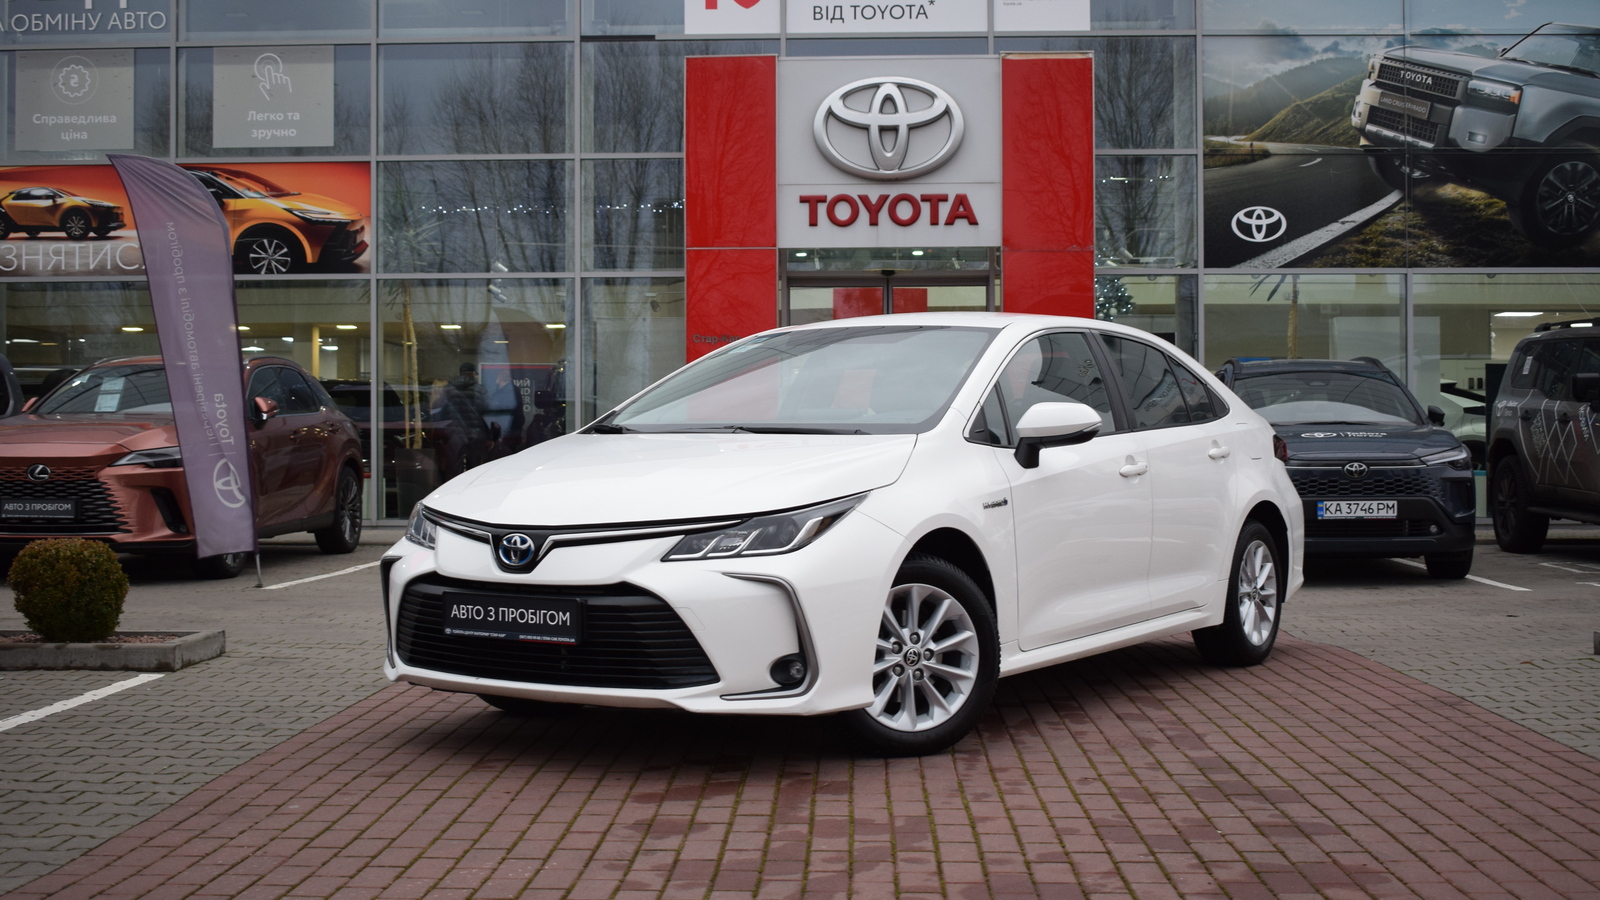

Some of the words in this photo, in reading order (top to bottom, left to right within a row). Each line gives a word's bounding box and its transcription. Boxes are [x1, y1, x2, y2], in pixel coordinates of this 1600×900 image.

[813, 5, 845, 24] ВІД
[11, 12, 102, 32] ОБМІНУ
[107, 11, 167, 30] АВТО
[1401, 71, 1432, 84] TOYOTA
[1412, 104, 1425, 112] PRADO
[33, 112, 117, 126] Справедлива
[247, 110, 284, 122] Легко
[286, 111, 300, 121] та
[61, 129, 88, 142] ціна
[251, 127, 297, 139] зручно
[799, 193, 979, 228] TOYOTA
[0, 243, 146, 271] ЗНЯТИС
[1324, 502, 1343, 515] KA
[1345, 502, 1375, 515] 3746
[1377, 502, 1396, 515] PM
[450, 604, 484, 621] АВТО
[486, 606, 496, 621] З
[498, 607, 571, 626] ПРОБІГОМ
